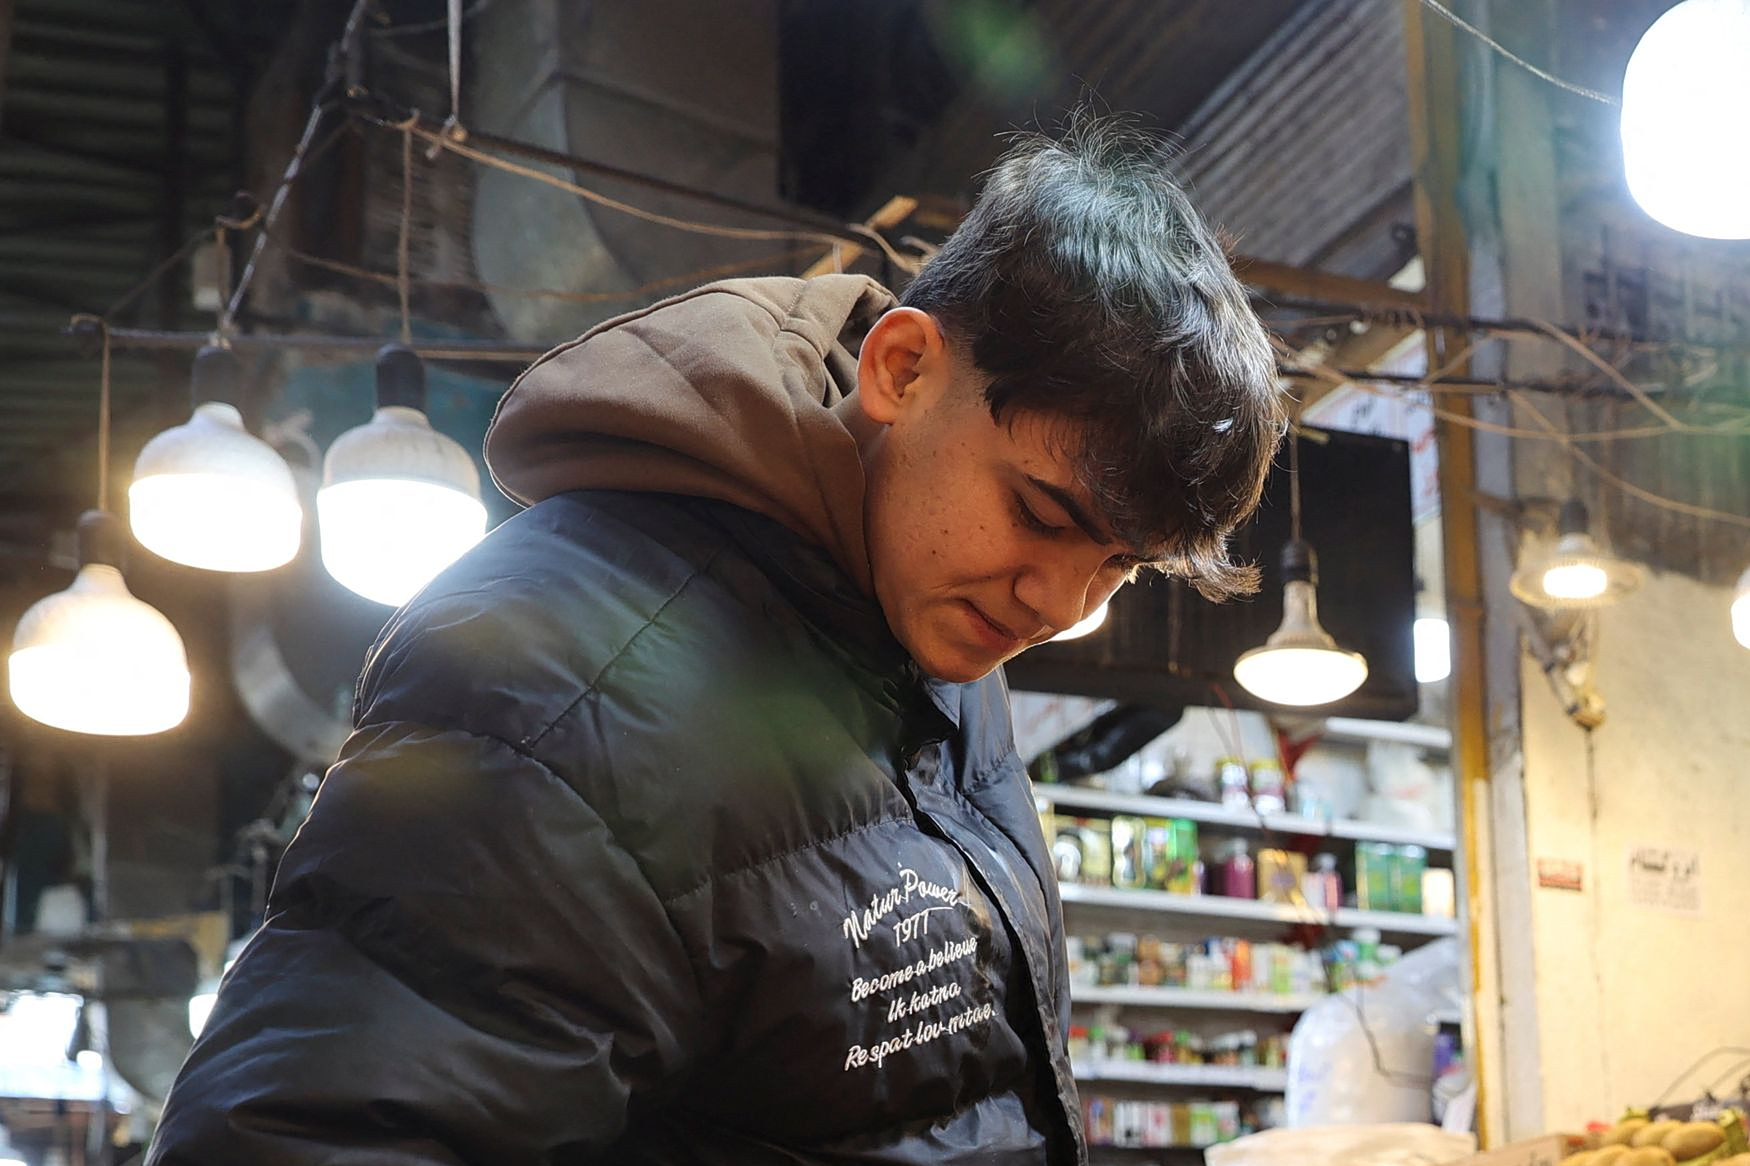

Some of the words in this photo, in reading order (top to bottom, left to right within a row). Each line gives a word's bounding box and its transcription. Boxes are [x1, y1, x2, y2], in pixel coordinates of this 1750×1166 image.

[843, 887, 901, 949] Natur
[899, 868, 962, 906] Power
[893, 907, 953, 948] 1977
[851, 965, 914, 1002] Become
[915, 959, 928, 977] a
[927, 937, 978, 973] believe
